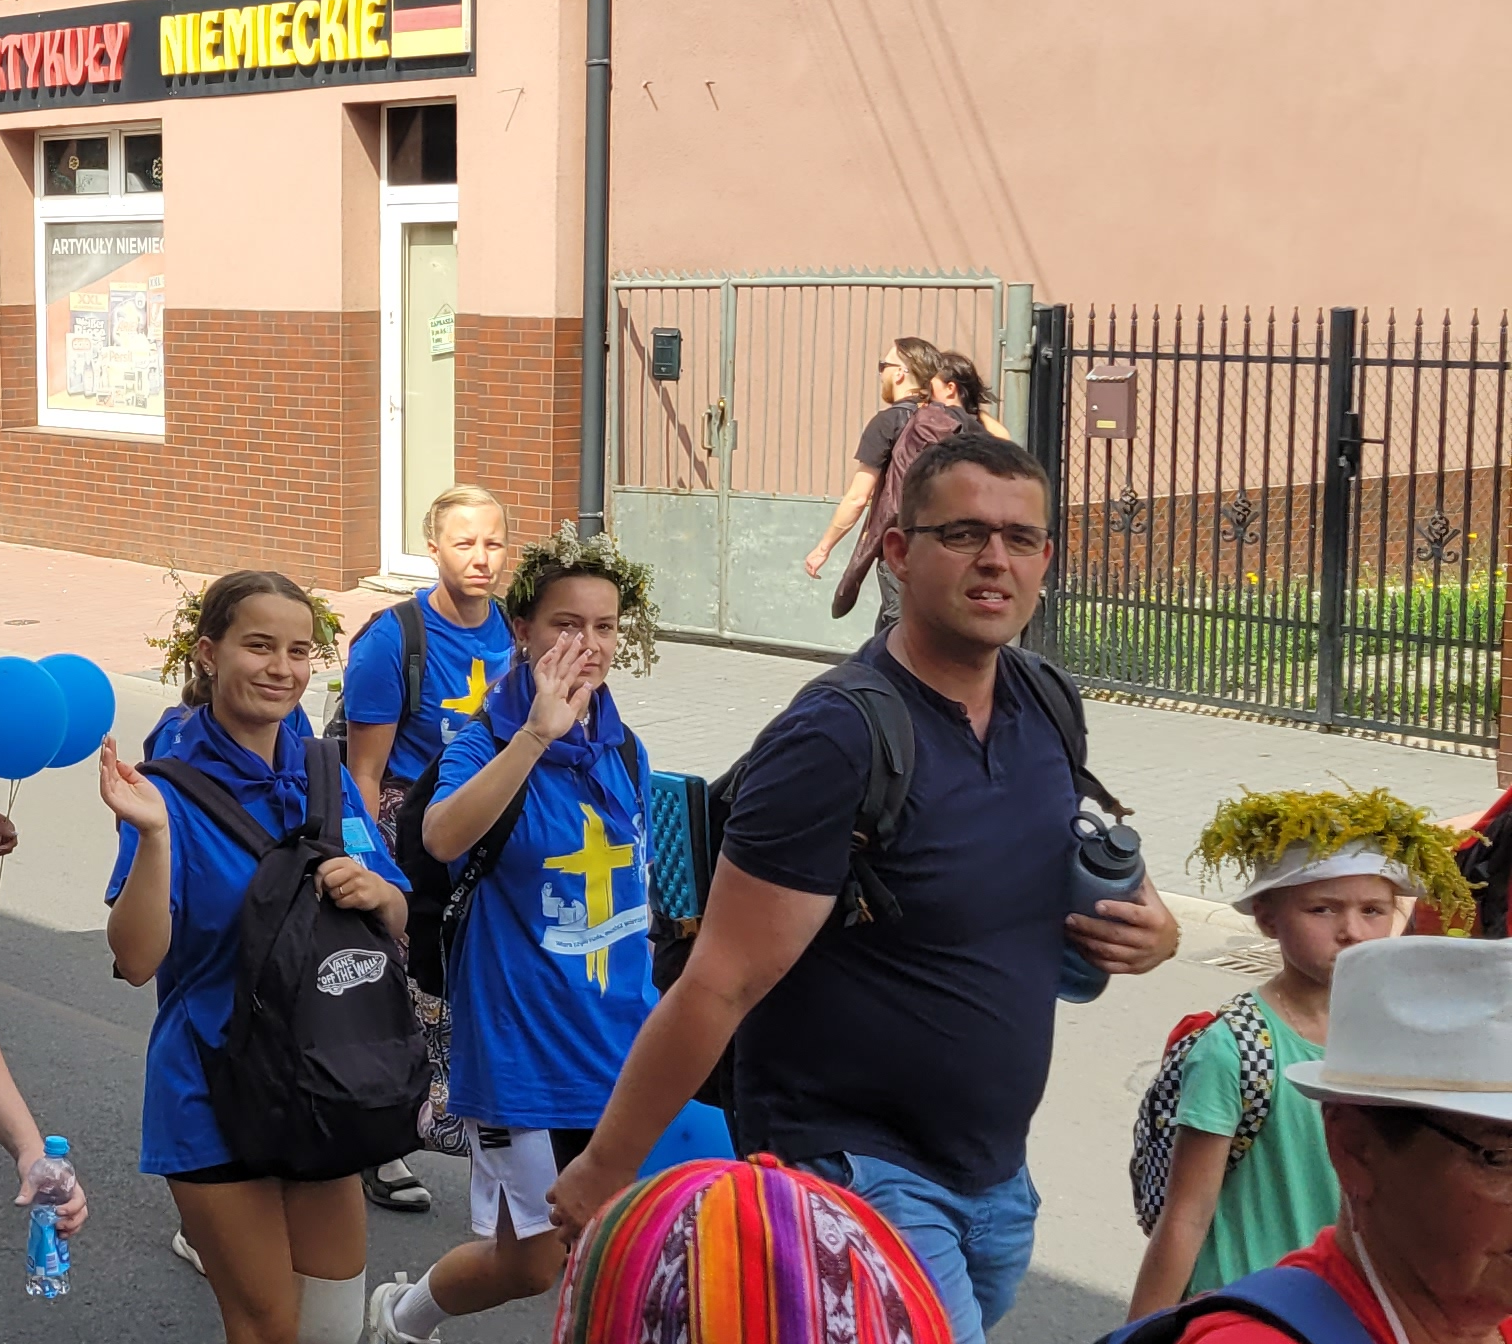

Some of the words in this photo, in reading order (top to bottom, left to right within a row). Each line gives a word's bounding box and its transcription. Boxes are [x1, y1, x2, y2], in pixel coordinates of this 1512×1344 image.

[51, 238, 114, 255] ARTYKUŁY
[77, 294, 103, 305] XXL
[328, 954, 355, 974] VANS
[336, 966, 355, 983] THE
